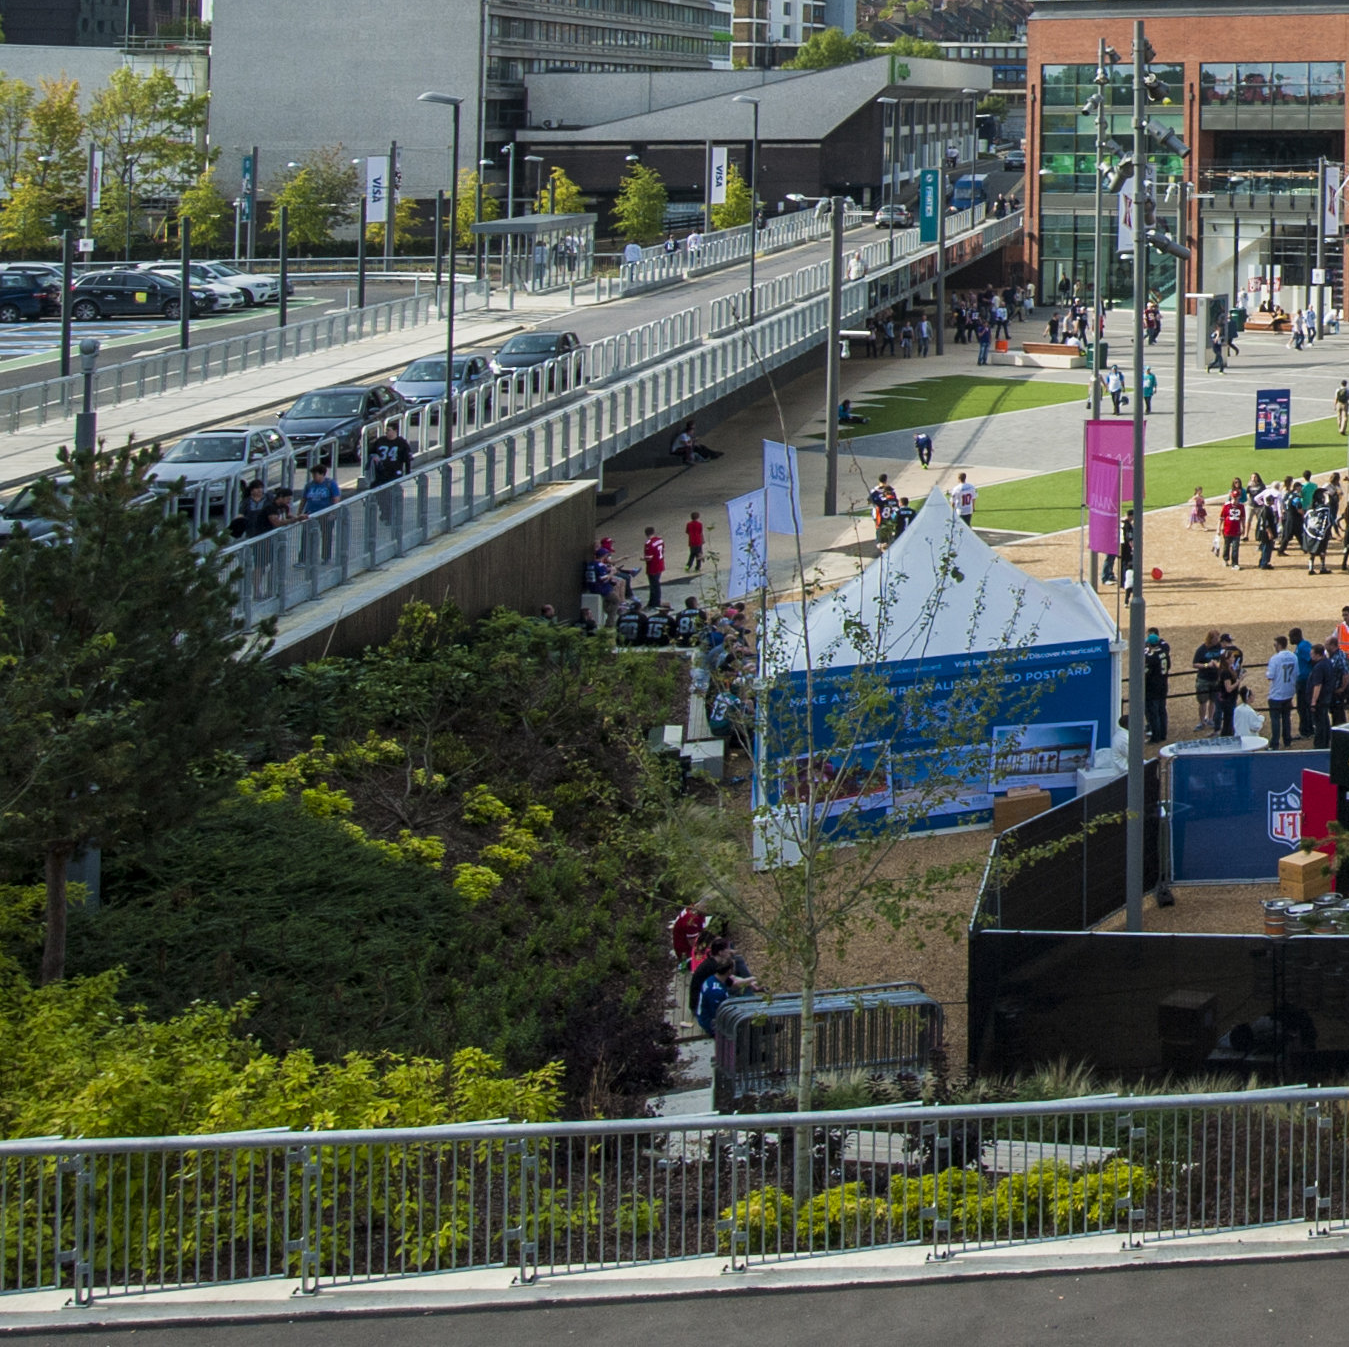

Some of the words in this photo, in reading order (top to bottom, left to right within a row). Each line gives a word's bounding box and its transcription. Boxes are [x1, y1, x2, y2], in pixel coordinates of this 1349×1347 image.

[715, 164, 724, 188] VISA
[372, 174, 383, 203] VISA
[378, 446, 399, 461] 34
[769, 461, 789, 482] US
[961, 493, 972, 506] 10
[1282, 663, 1295, 684] 17
[711, 698, 727, 721] 13
